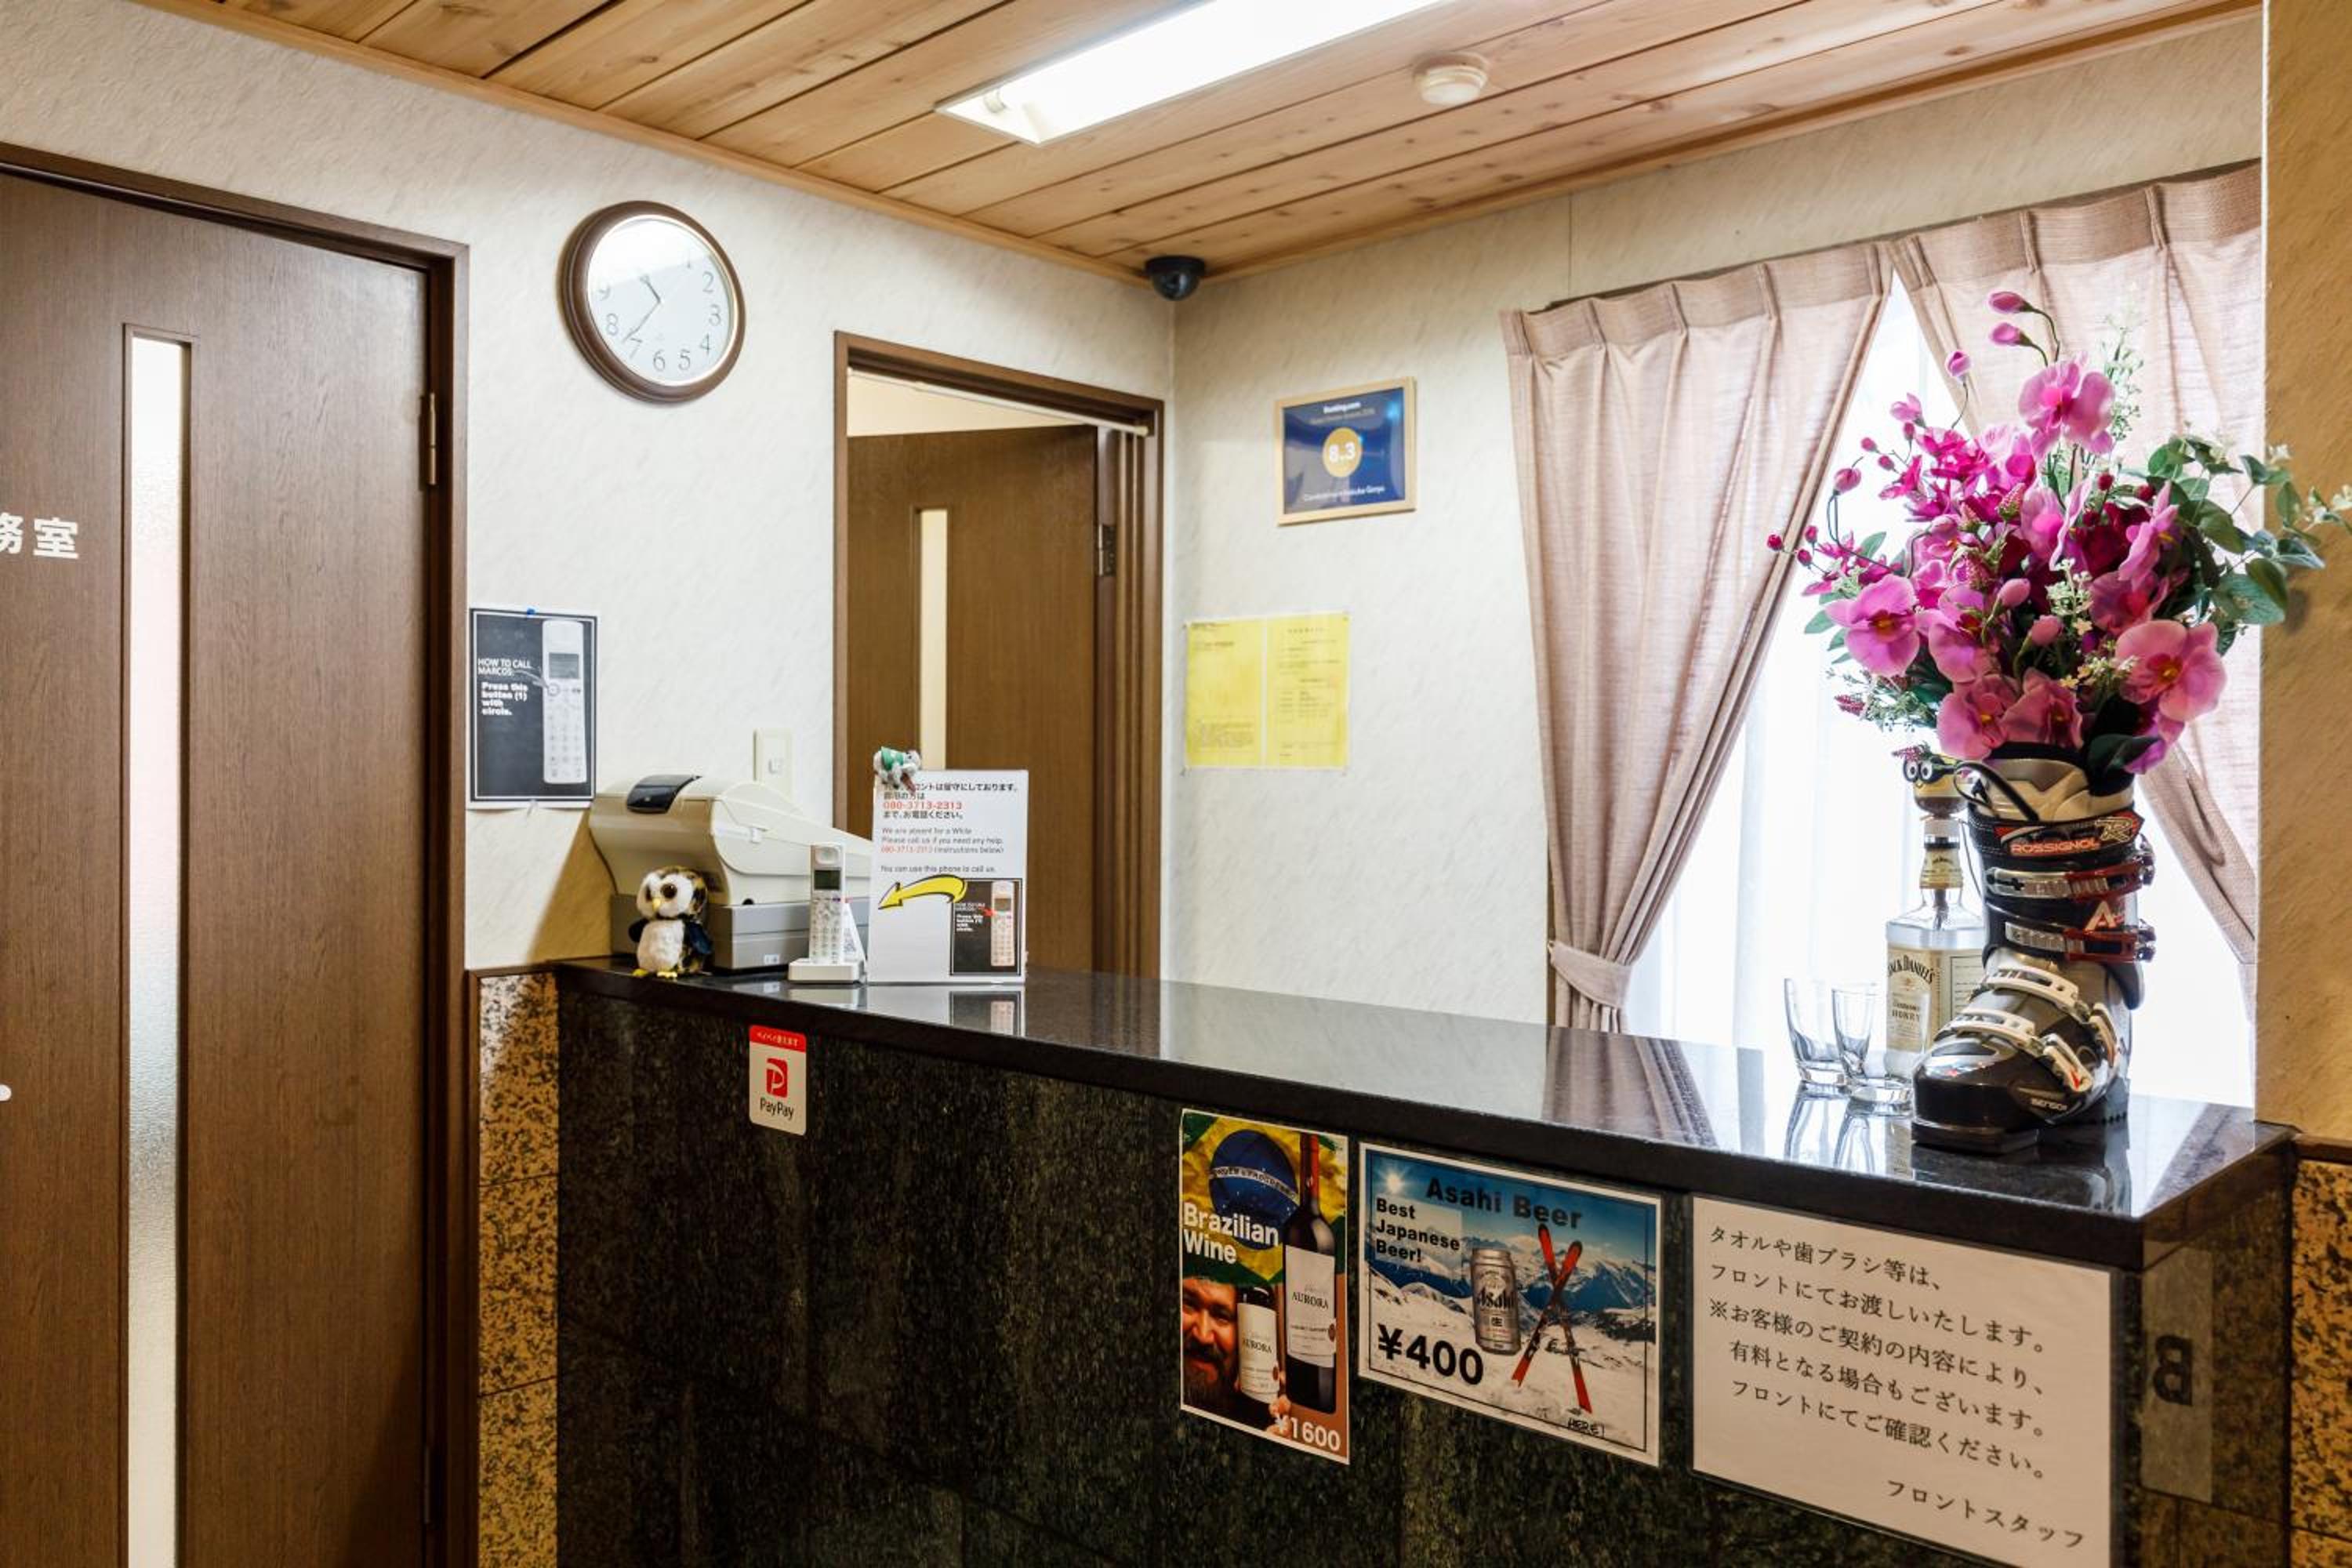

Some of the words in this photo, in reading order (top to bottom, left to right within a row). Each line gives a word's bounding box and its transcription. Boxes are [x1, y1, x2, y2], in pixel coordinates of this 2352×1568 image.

[702, 271, 714, 293] 2
[605, 313, 619, 336] 8
[709, 303, 721, 325] 3
[630, 336, 643, 359] 7
[699, 334, 712, 354] 4
[653, 349, 666, 372] 6
[678, 349, 691, 371] 5
[1328, 441, 1356, 463] 8.3
[477, 658, 499, 666] HOW
[501, 659, 512, 667] TO
[513, 659, 531, 669] CALL
[481, 681, 509, 691] Press
[510, 682, 528, 691] this
[481, 690, 513, 699] button
[514, 691, 528, 702] (1)
[2010, 837, 2100, 855] ROSSIGNOL
[760, 1097, 794, 1120] PayPay
[1376, 1198, 1416, 1220] Best
[1426, 1178, 1501, 1213] Asahi
[1513, 1195, 1582, 1229] Beer
[1184, 1202, 1279, 1247] Brazilian
[1376, 1219, 1460, 1250] Japanese
[1184, 1229, 1236, 1264] Wine
[1376, 1240, 1421, 1262] Beer!
[1710, 1225, 1941, 1291] タオルや歯ブラシ等は、
[1291, 1291, 1329, 1310] AURORA
[1710, 1264, 2044, 1353] フロントにてお渡しいたします。
[1377, 1323, 1484, 1385] ¥400
[1730, 1341, 2044, 1437] 有料となる場合もございます。
[1733, 1380, 2044, 1479] フロントにてご確認ください。
[1887, 1479, 2084, 1548] フロントスタッフ
